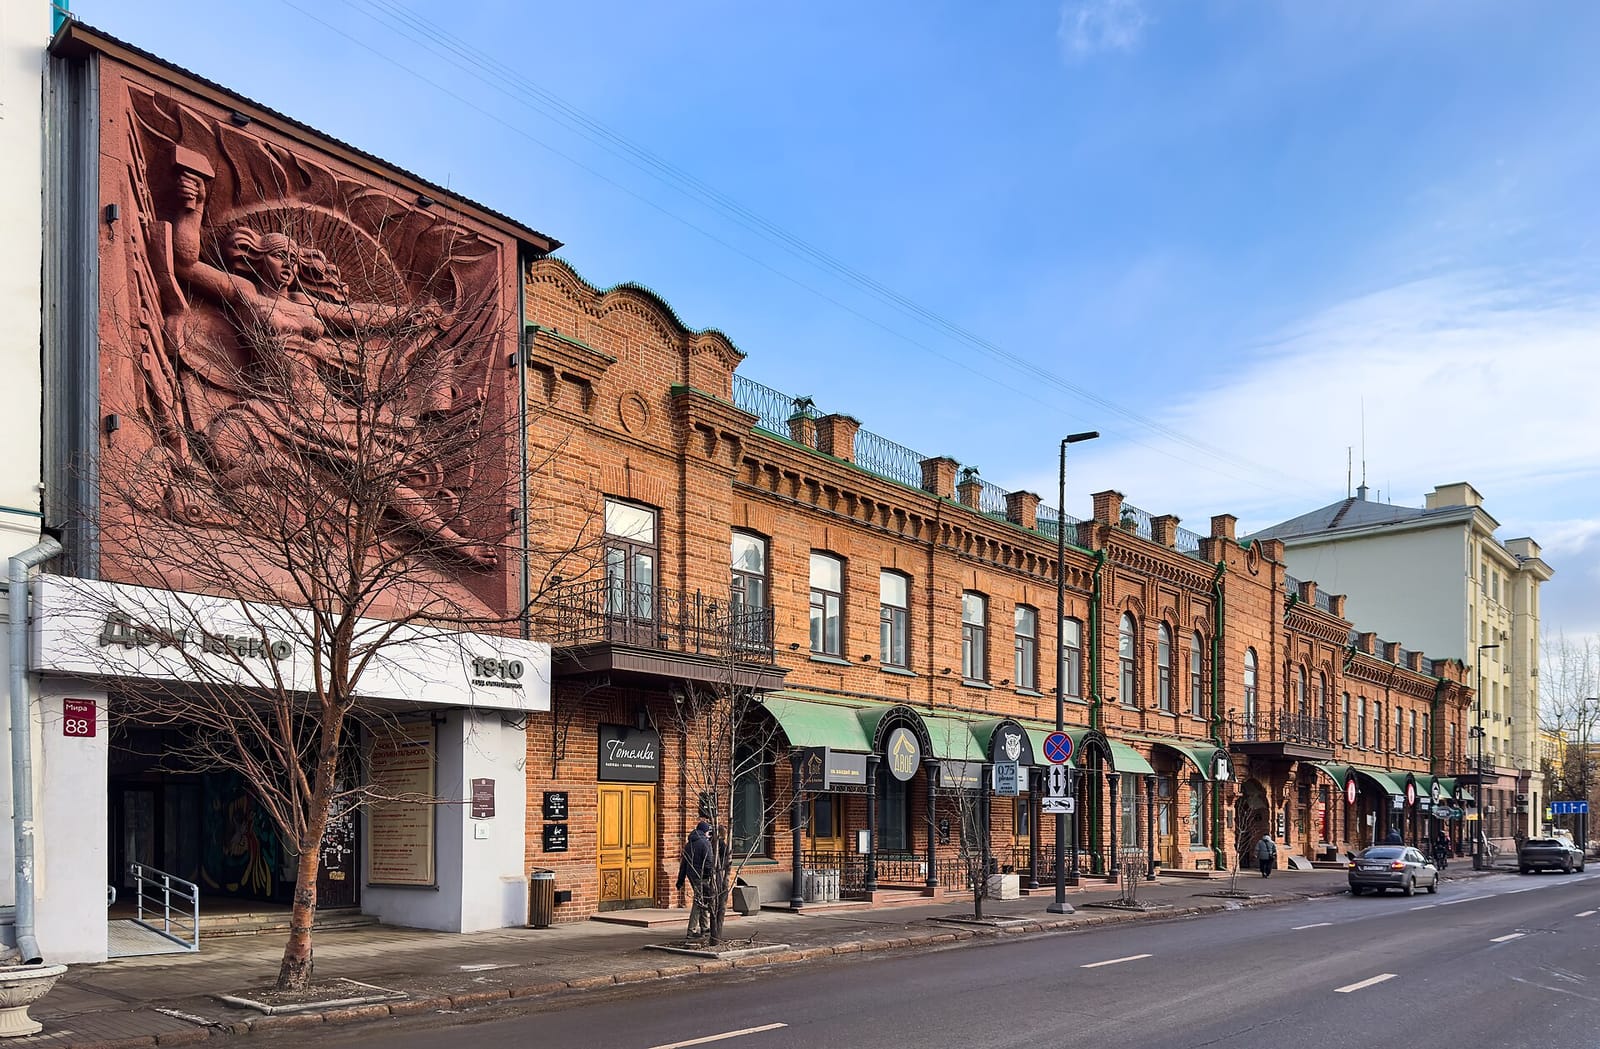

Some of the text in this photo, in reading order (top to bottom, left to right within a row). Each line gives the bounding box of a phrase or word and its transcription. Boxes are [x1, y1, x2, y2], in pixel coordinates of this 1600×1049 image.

[472, 656, 524, 680] 1910
[65, 704, 88, 712] Мира
[65, 719, 88, 734] 88
[606, 739, 655, 760] Тотемка
